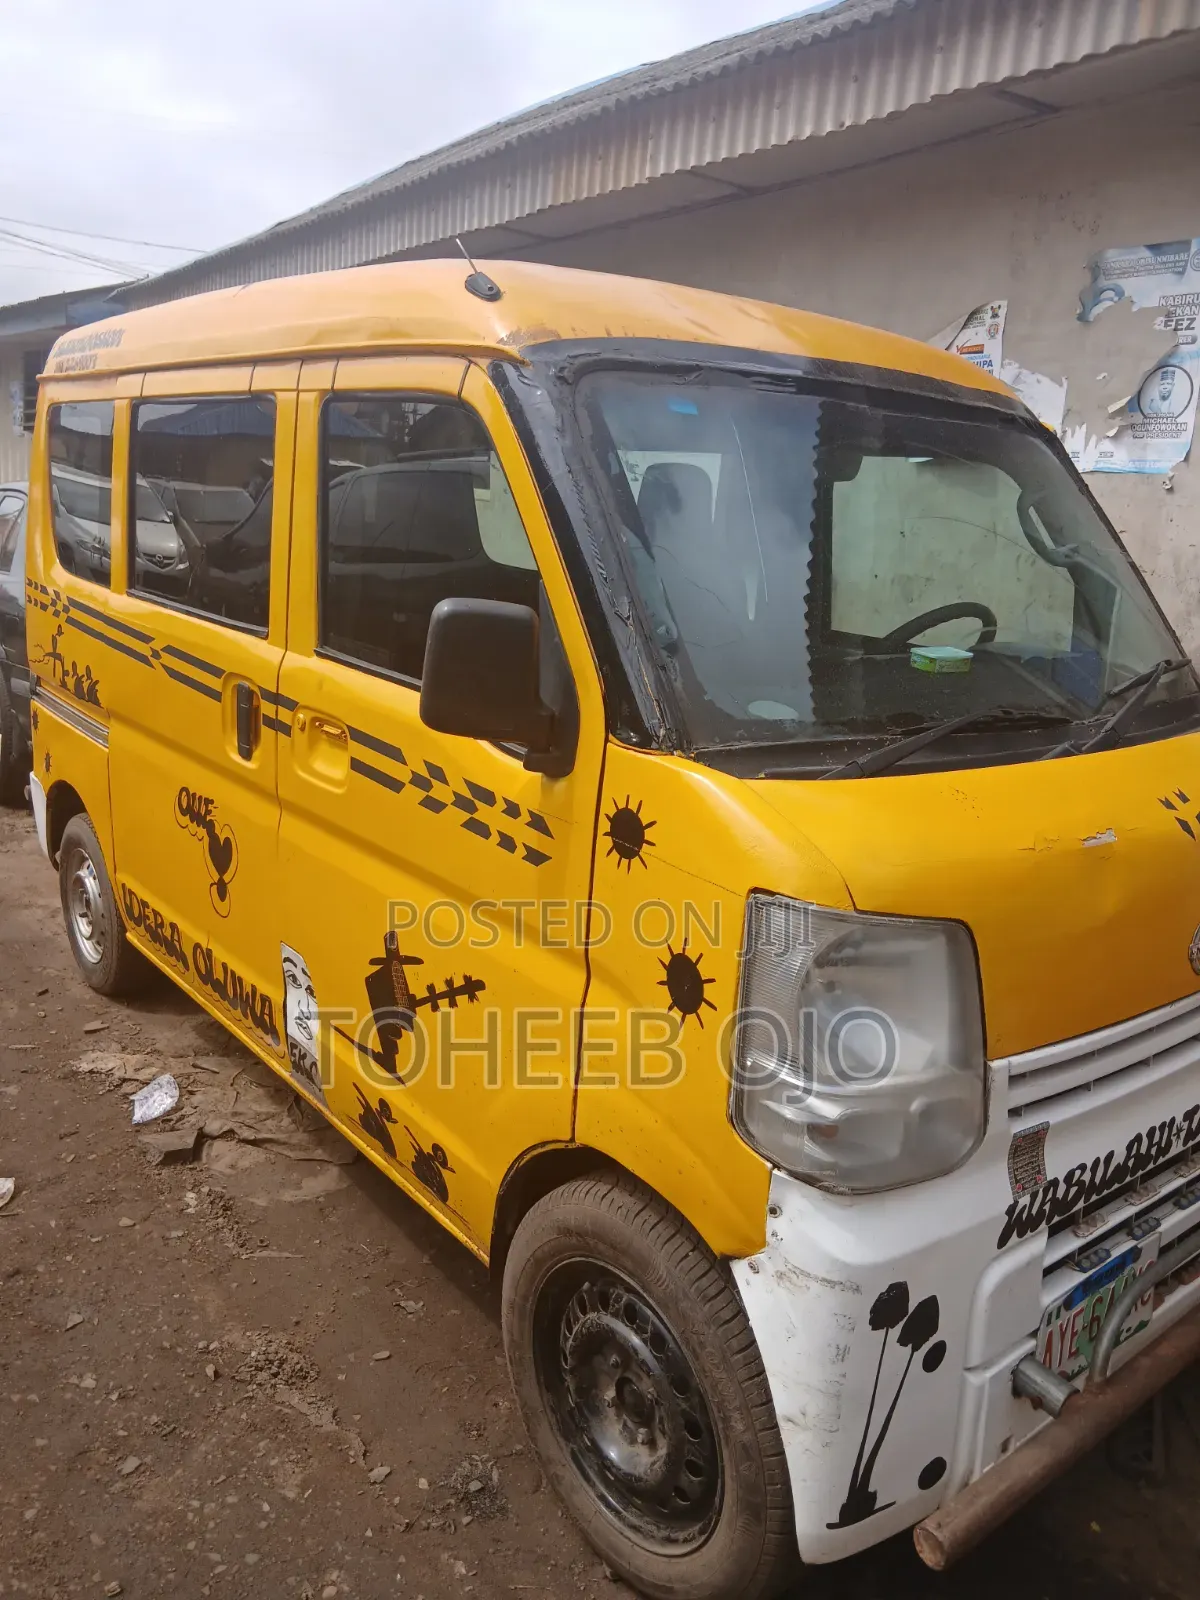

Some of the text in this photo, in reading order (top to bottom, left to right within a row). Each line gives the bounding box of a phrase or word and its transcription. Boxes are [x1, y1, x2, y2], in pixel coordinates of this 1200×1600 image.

[1131, 422, 1187, 432] OGUNFOWOKAN
[1146, 431, 1182, 439] PRESIDENT
[121, 882, 281, 1047] IDERA OLUWA
